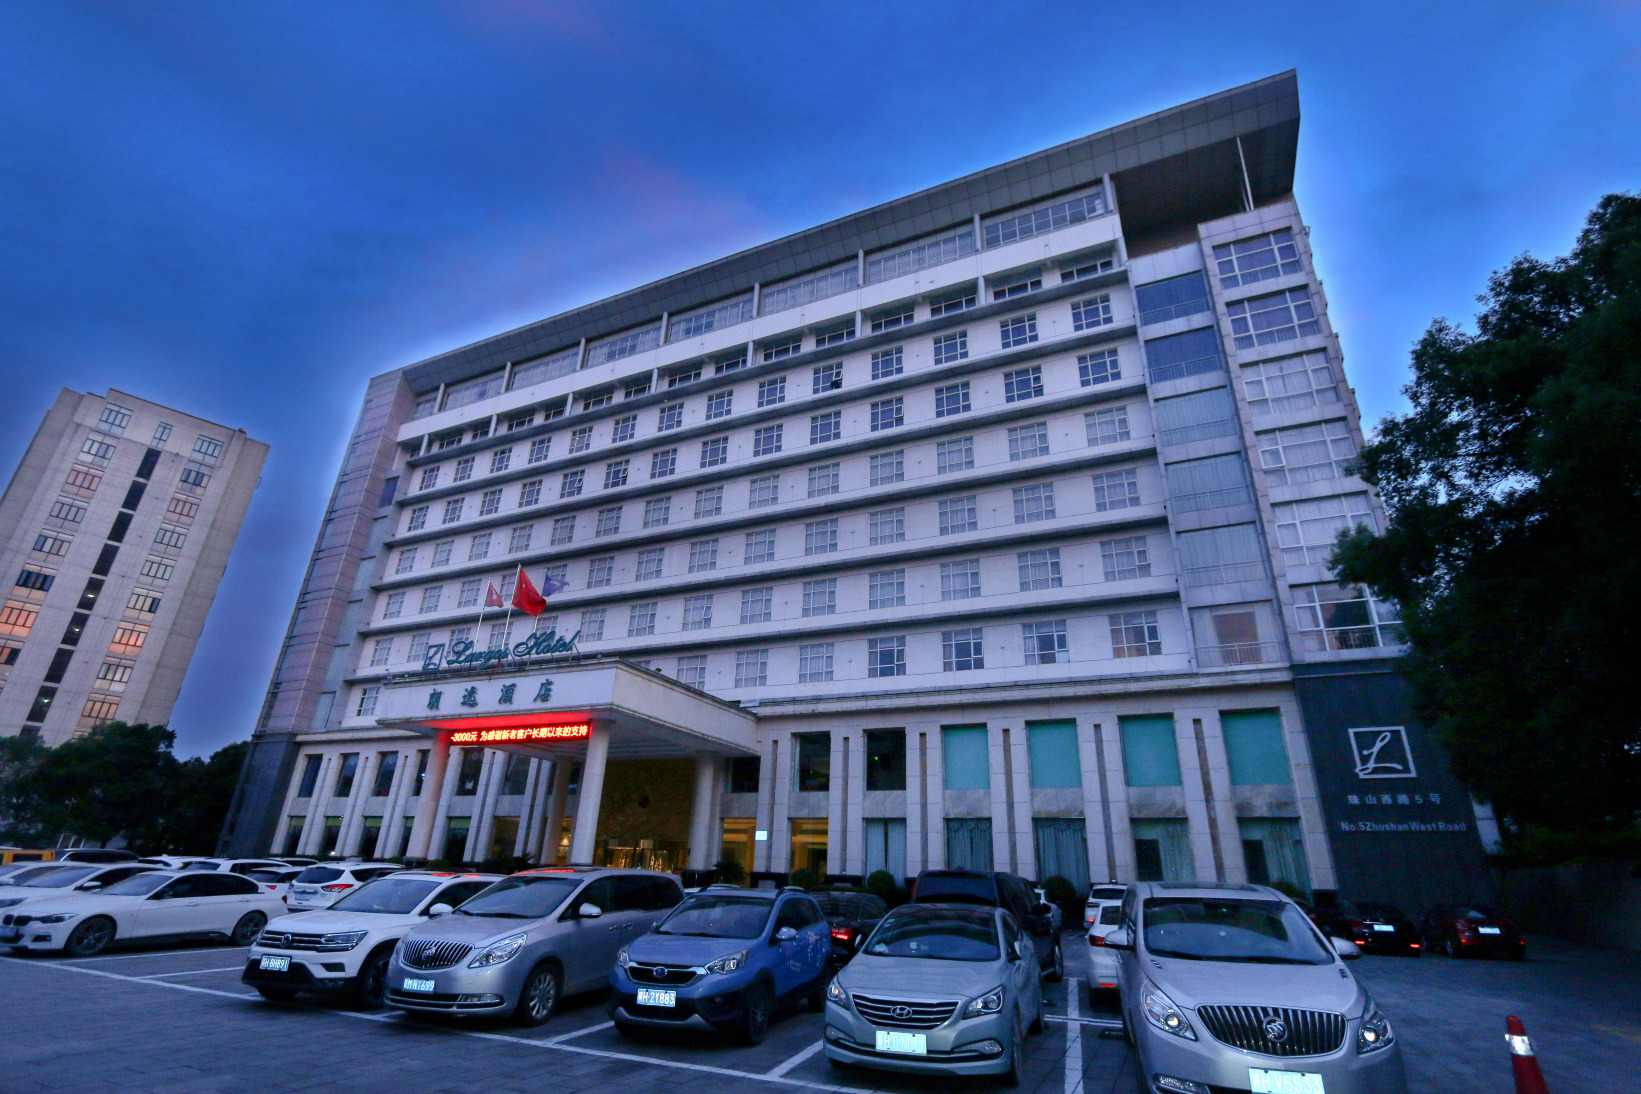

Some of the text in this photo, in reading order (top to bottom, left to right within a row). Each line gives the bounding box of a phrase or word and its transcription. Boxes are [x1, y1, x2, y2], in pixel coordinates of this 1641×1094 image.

[513, 630, 581, 657] Hotel
[479, 725, 588, 741] 为感谢新老客户长期以来的支持
[1347, 793, 1441, 805] 珠山西路5号
[1439, 822, 1467, 831] Road
